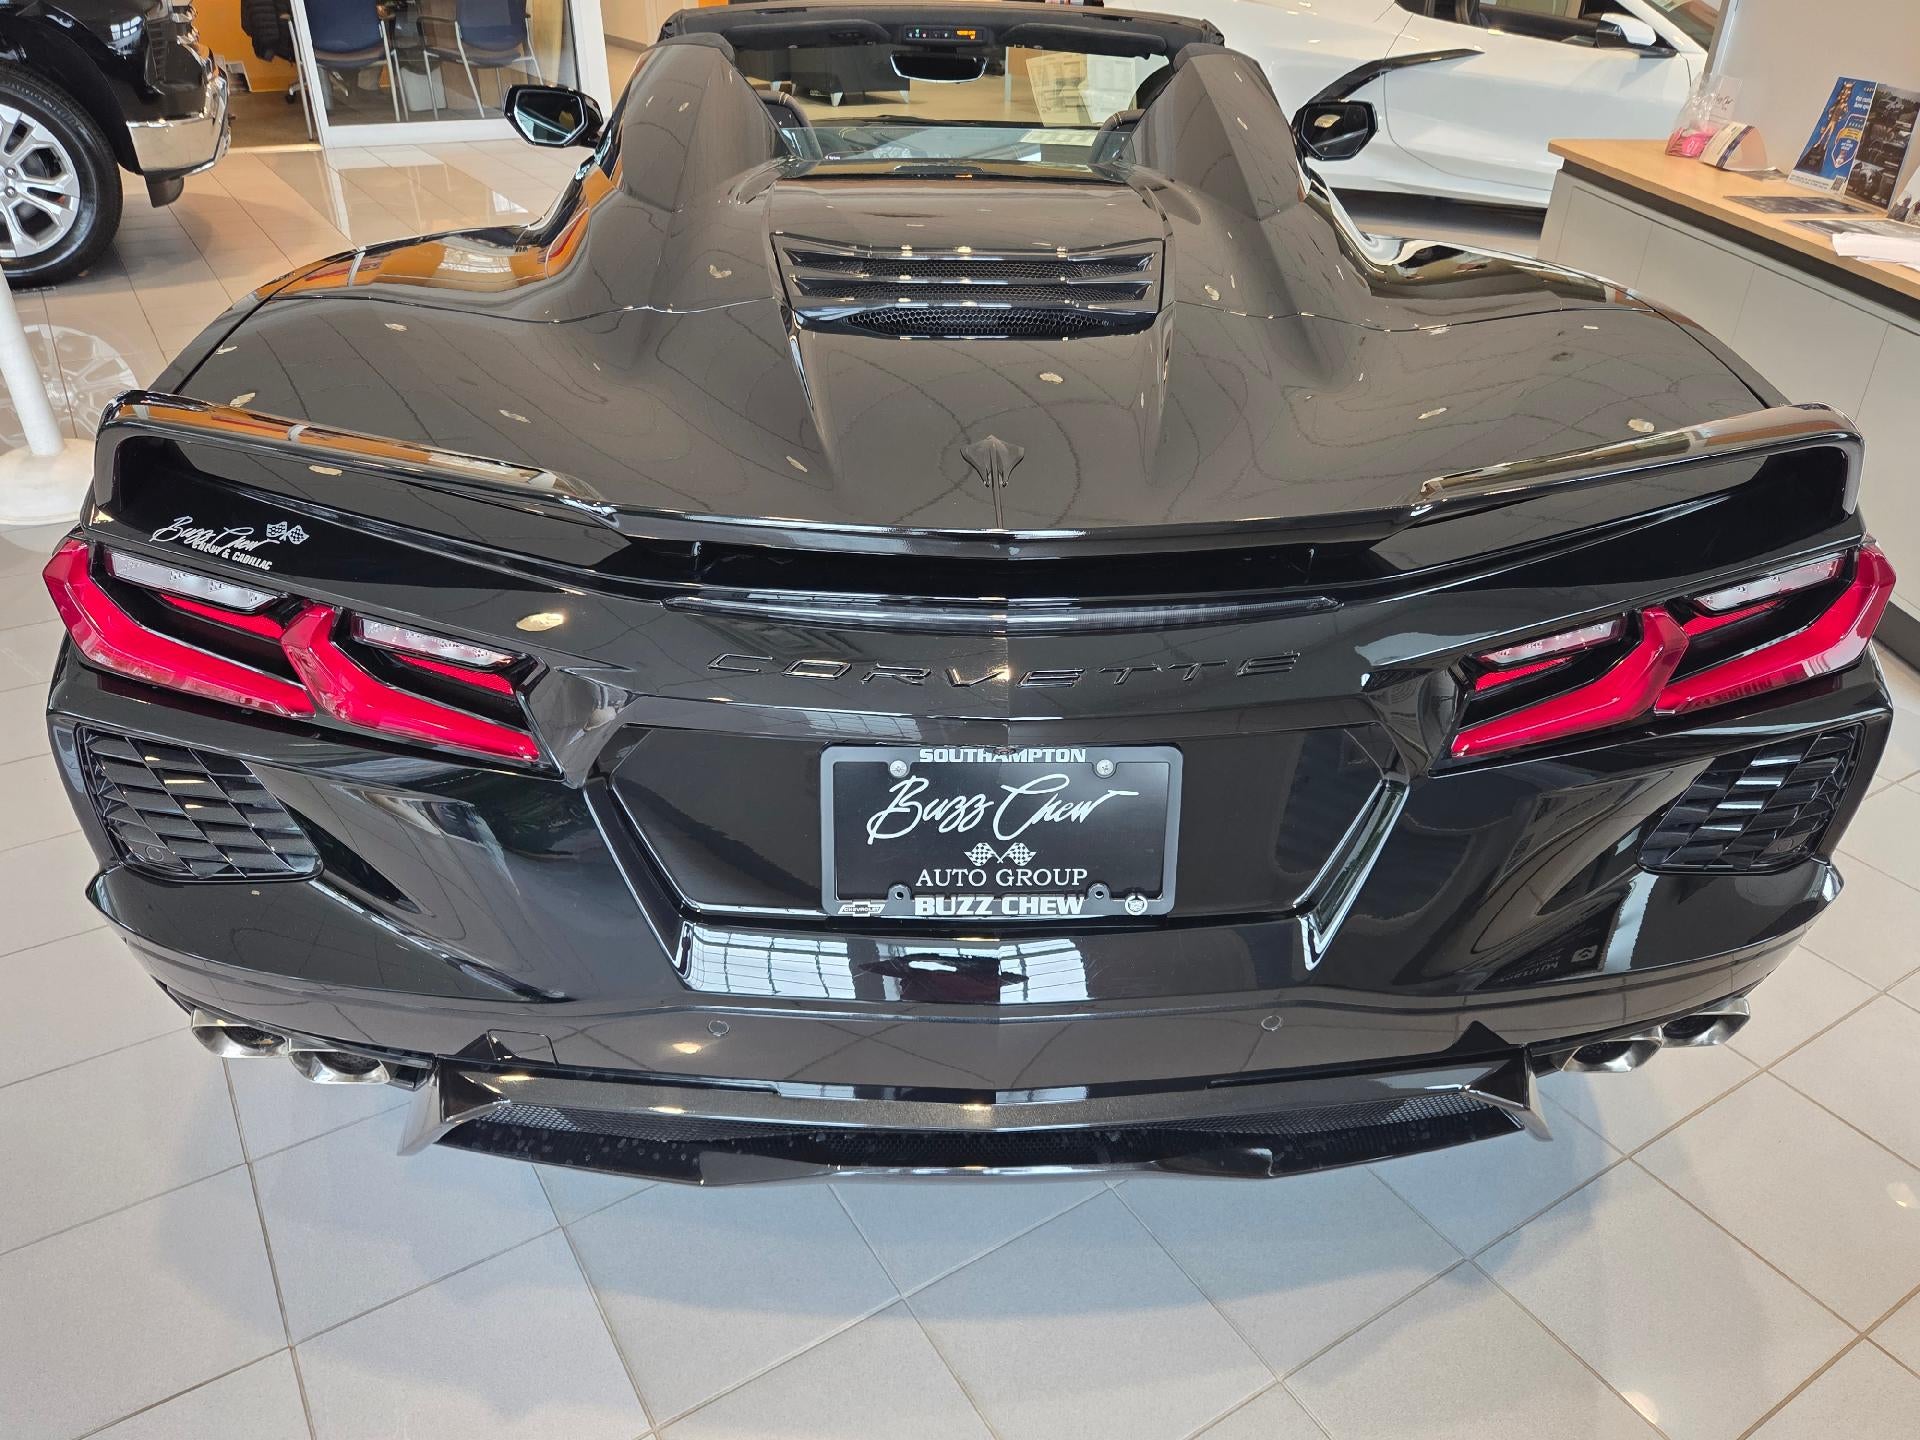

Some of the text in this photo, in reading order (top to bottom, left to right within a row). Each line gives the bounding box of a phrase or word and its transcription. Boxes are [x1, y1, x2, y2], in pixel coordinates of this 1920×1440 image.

[149, 515, 281, 552] Buzz Chew
[221, 549, 231, 559] &
[231, 551, 273, 571] CADILLAC
[706, 648, 1302, 689] CORVETTE
[919, 748, 1087, 763] SOUTHAMPTON
[866, 773, 1140, 845] Buzz Chew
[915, 868, 1088, 887] AUTO GROUP
[914, 895, 1085, 916] BUZZ CHEW
